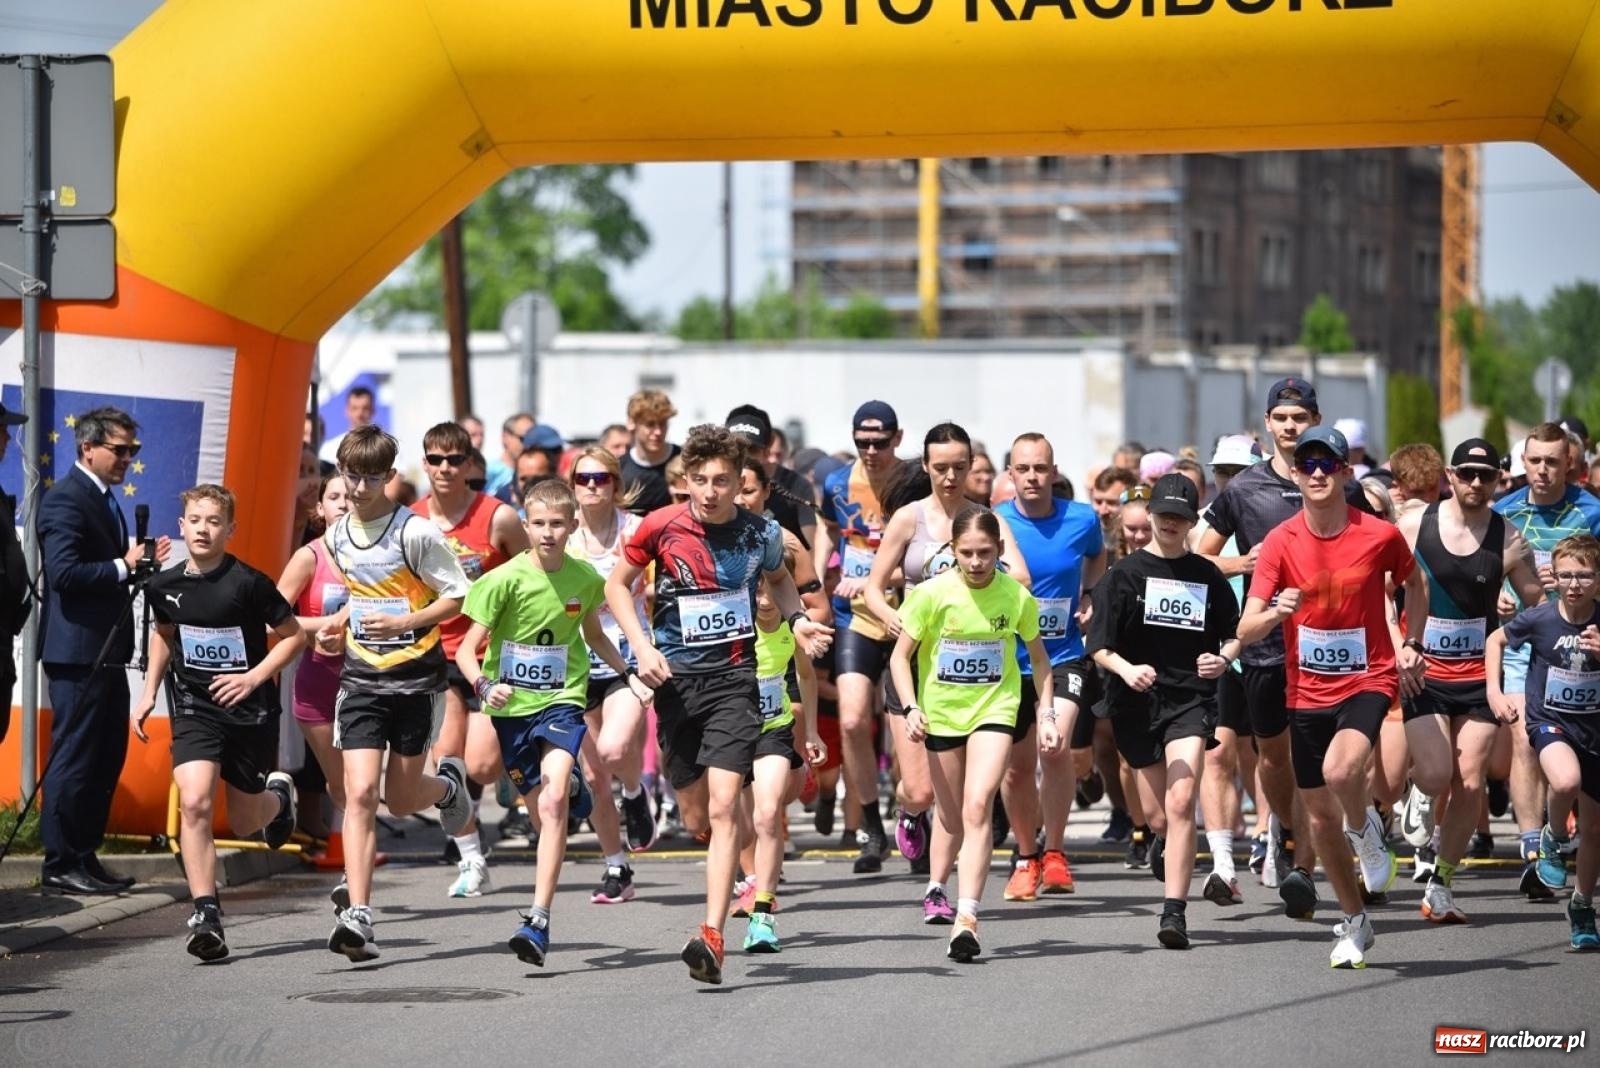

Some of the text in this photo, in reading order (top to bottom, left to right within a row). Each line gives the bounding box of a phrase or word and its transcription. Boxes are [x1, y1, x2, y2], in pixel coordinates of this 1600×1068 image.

[1160, 598, 1192, 616] 066
[698, 611, 736, 631] 056
[1038, 615, 1058, 628] 09
[1440, 636, 1470, 649] 041
[194, 644, 230, 659] 060
[1313, 648, 1350, 663] 039
[515, 663, 552, 680] 065
[953, 658, 989, 674] 055
[1562, 687, 1598, 703] 052
